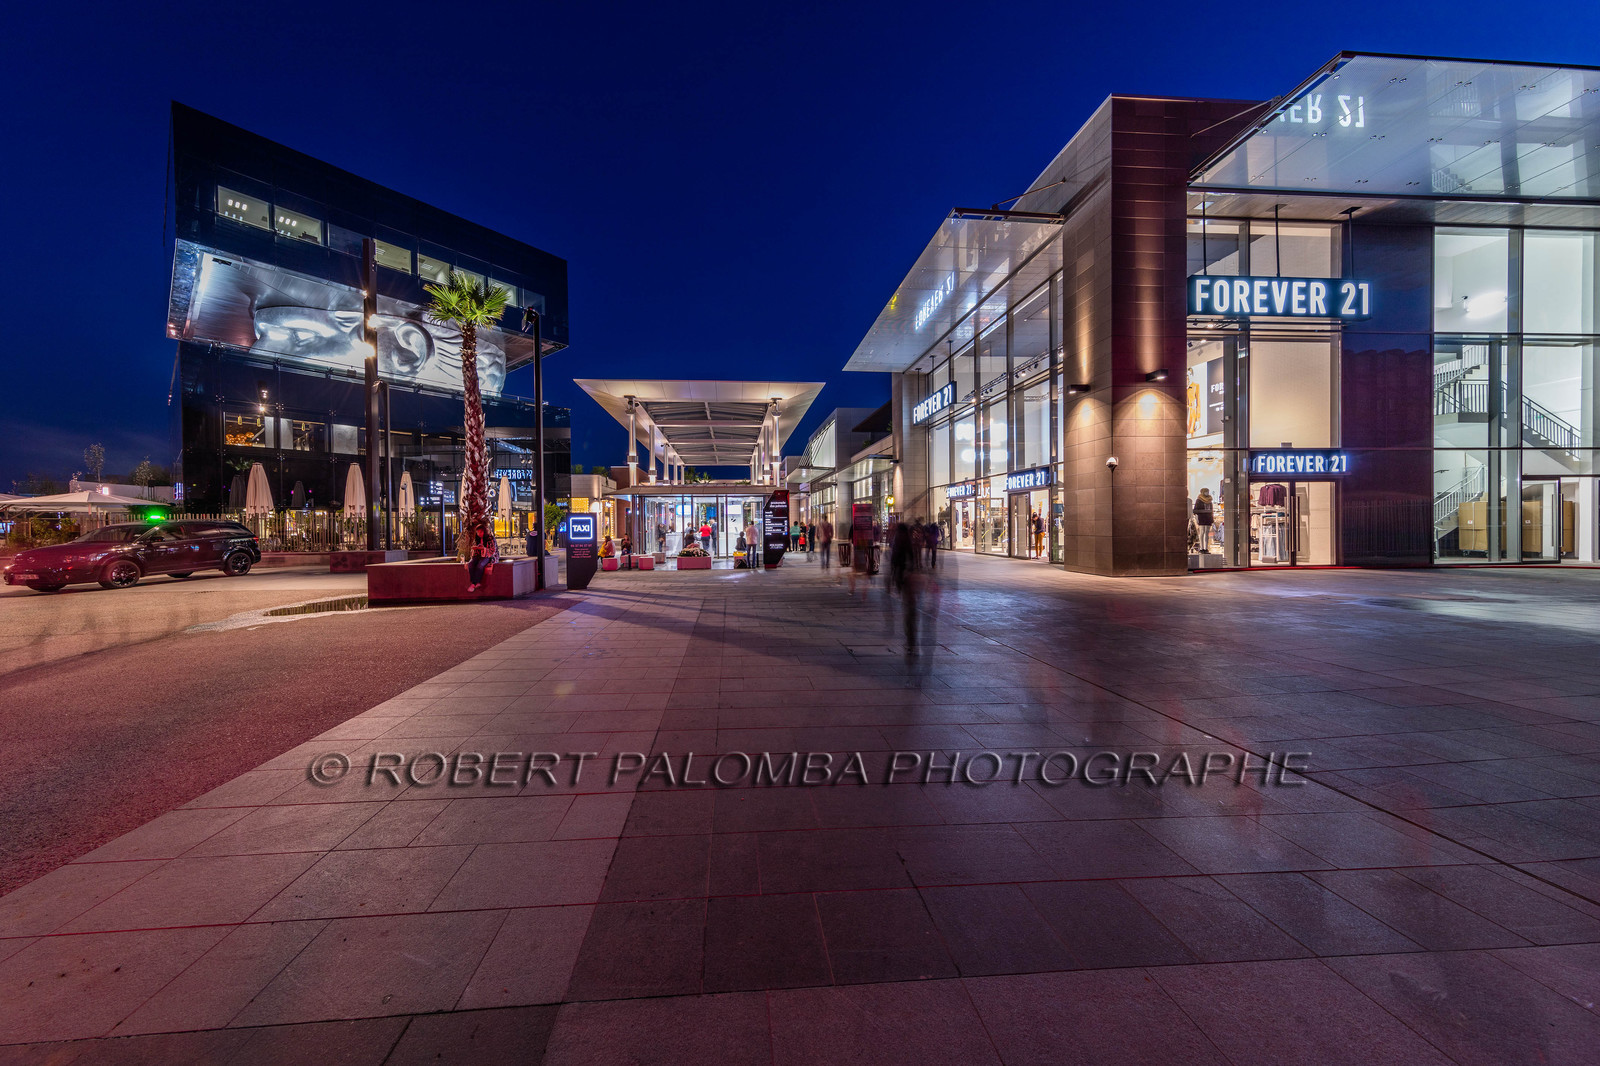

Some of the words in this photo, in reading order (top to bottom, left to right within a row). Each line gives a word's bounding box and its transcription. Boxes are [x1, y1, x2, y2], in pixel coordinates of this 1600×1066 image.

[1195, 279, 1327, 314] FOREVER
[1341, 282, 1369, 315] 21
[913, 391, 942, 424] FOREVER
[943, 384, 952, 407] 21
[1257, 455, 1325, 473] FOREVER
[1331, 455, 1347, 472] 21
[1005, 475, 1034, 490] FOREVER
[1036, 471, 1045, 486] 21
[572, 524, 590, 532] TAXI
